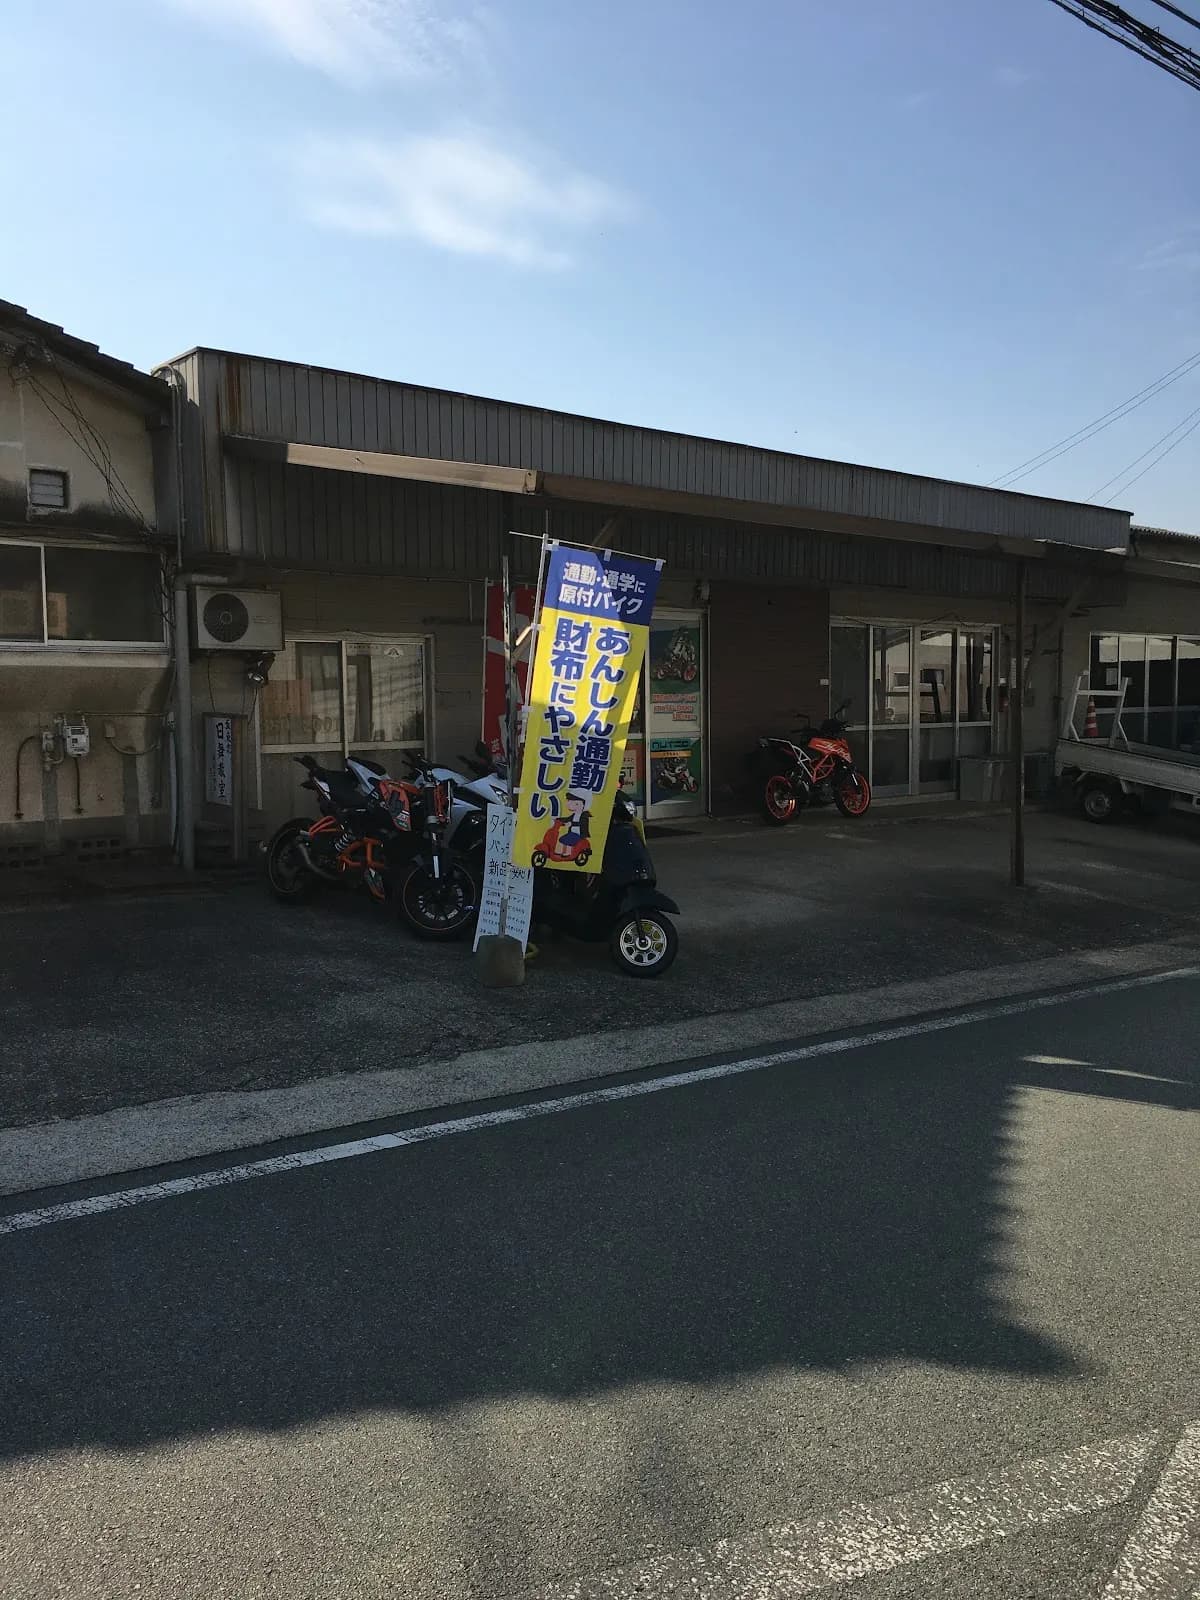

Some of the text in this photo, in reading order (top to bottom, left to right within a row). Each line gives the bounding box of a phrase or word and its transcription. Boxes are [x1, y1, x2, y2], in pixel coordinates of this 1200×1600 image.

[559, 584, 643, 615] 原付バイク
[563, 562, 646, 594] 通勤・通学に
[529, 617, 592, 819] 財布にやさしい
[569, 626, 630, 792] あんしん通勤
